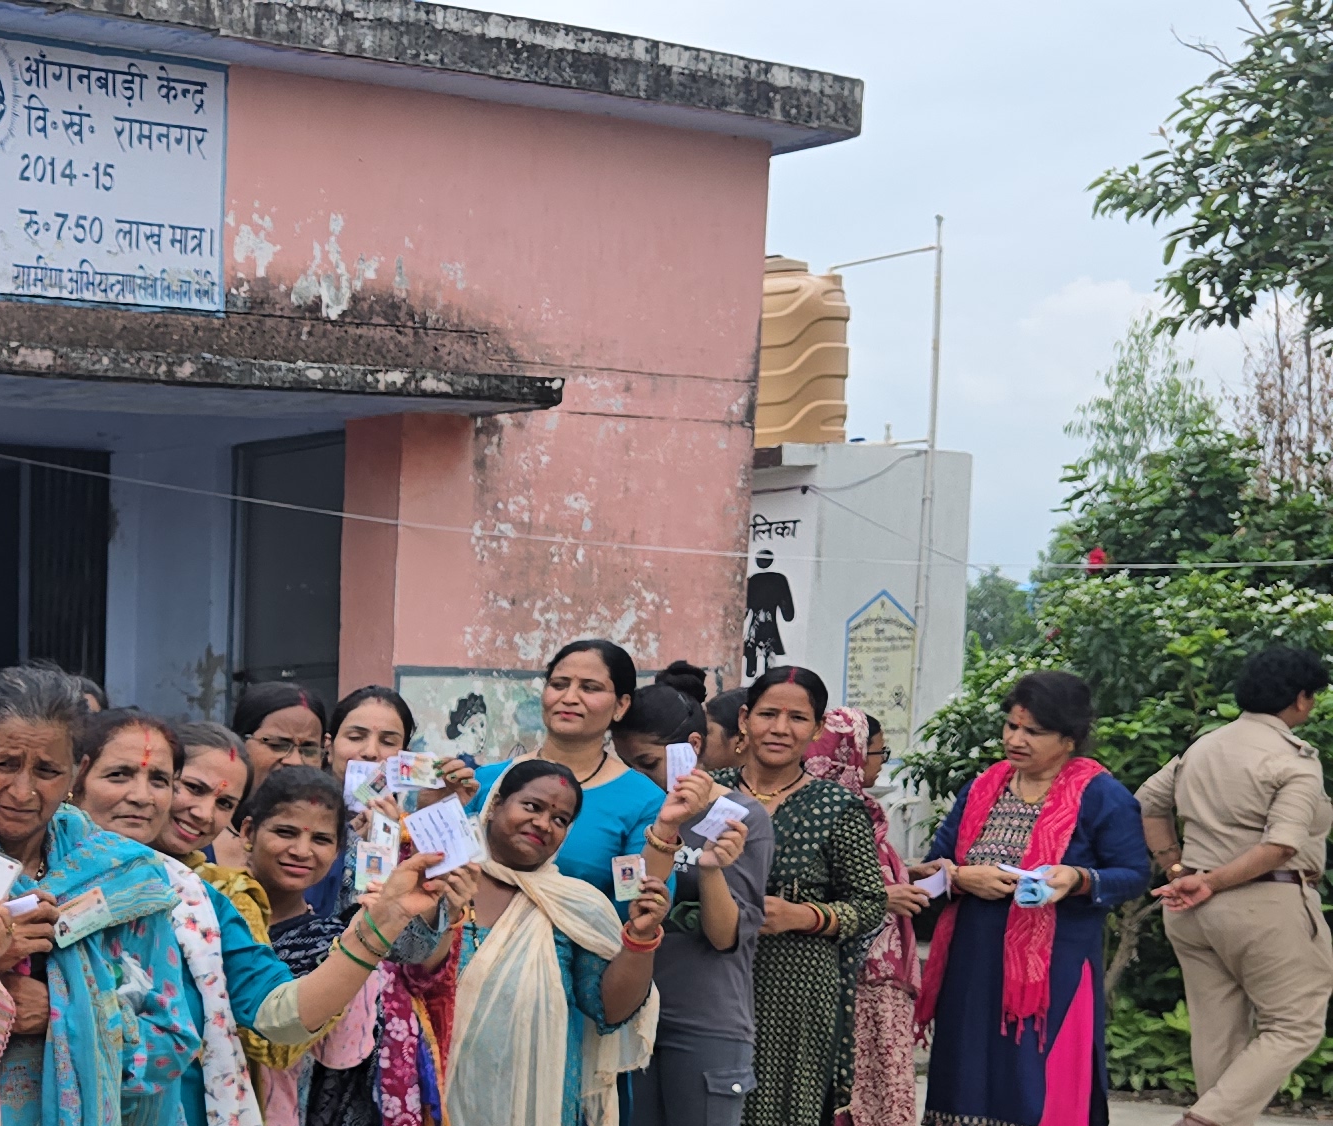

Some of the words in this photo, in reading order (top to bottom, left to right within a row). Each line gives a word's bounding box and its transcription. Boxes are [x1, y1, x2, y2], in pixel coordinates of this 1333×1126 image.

[113, 115, 209, 161] रामनगर
[114, 218, 166, 256] लाख
[749, 512, 801, 543] लिका
